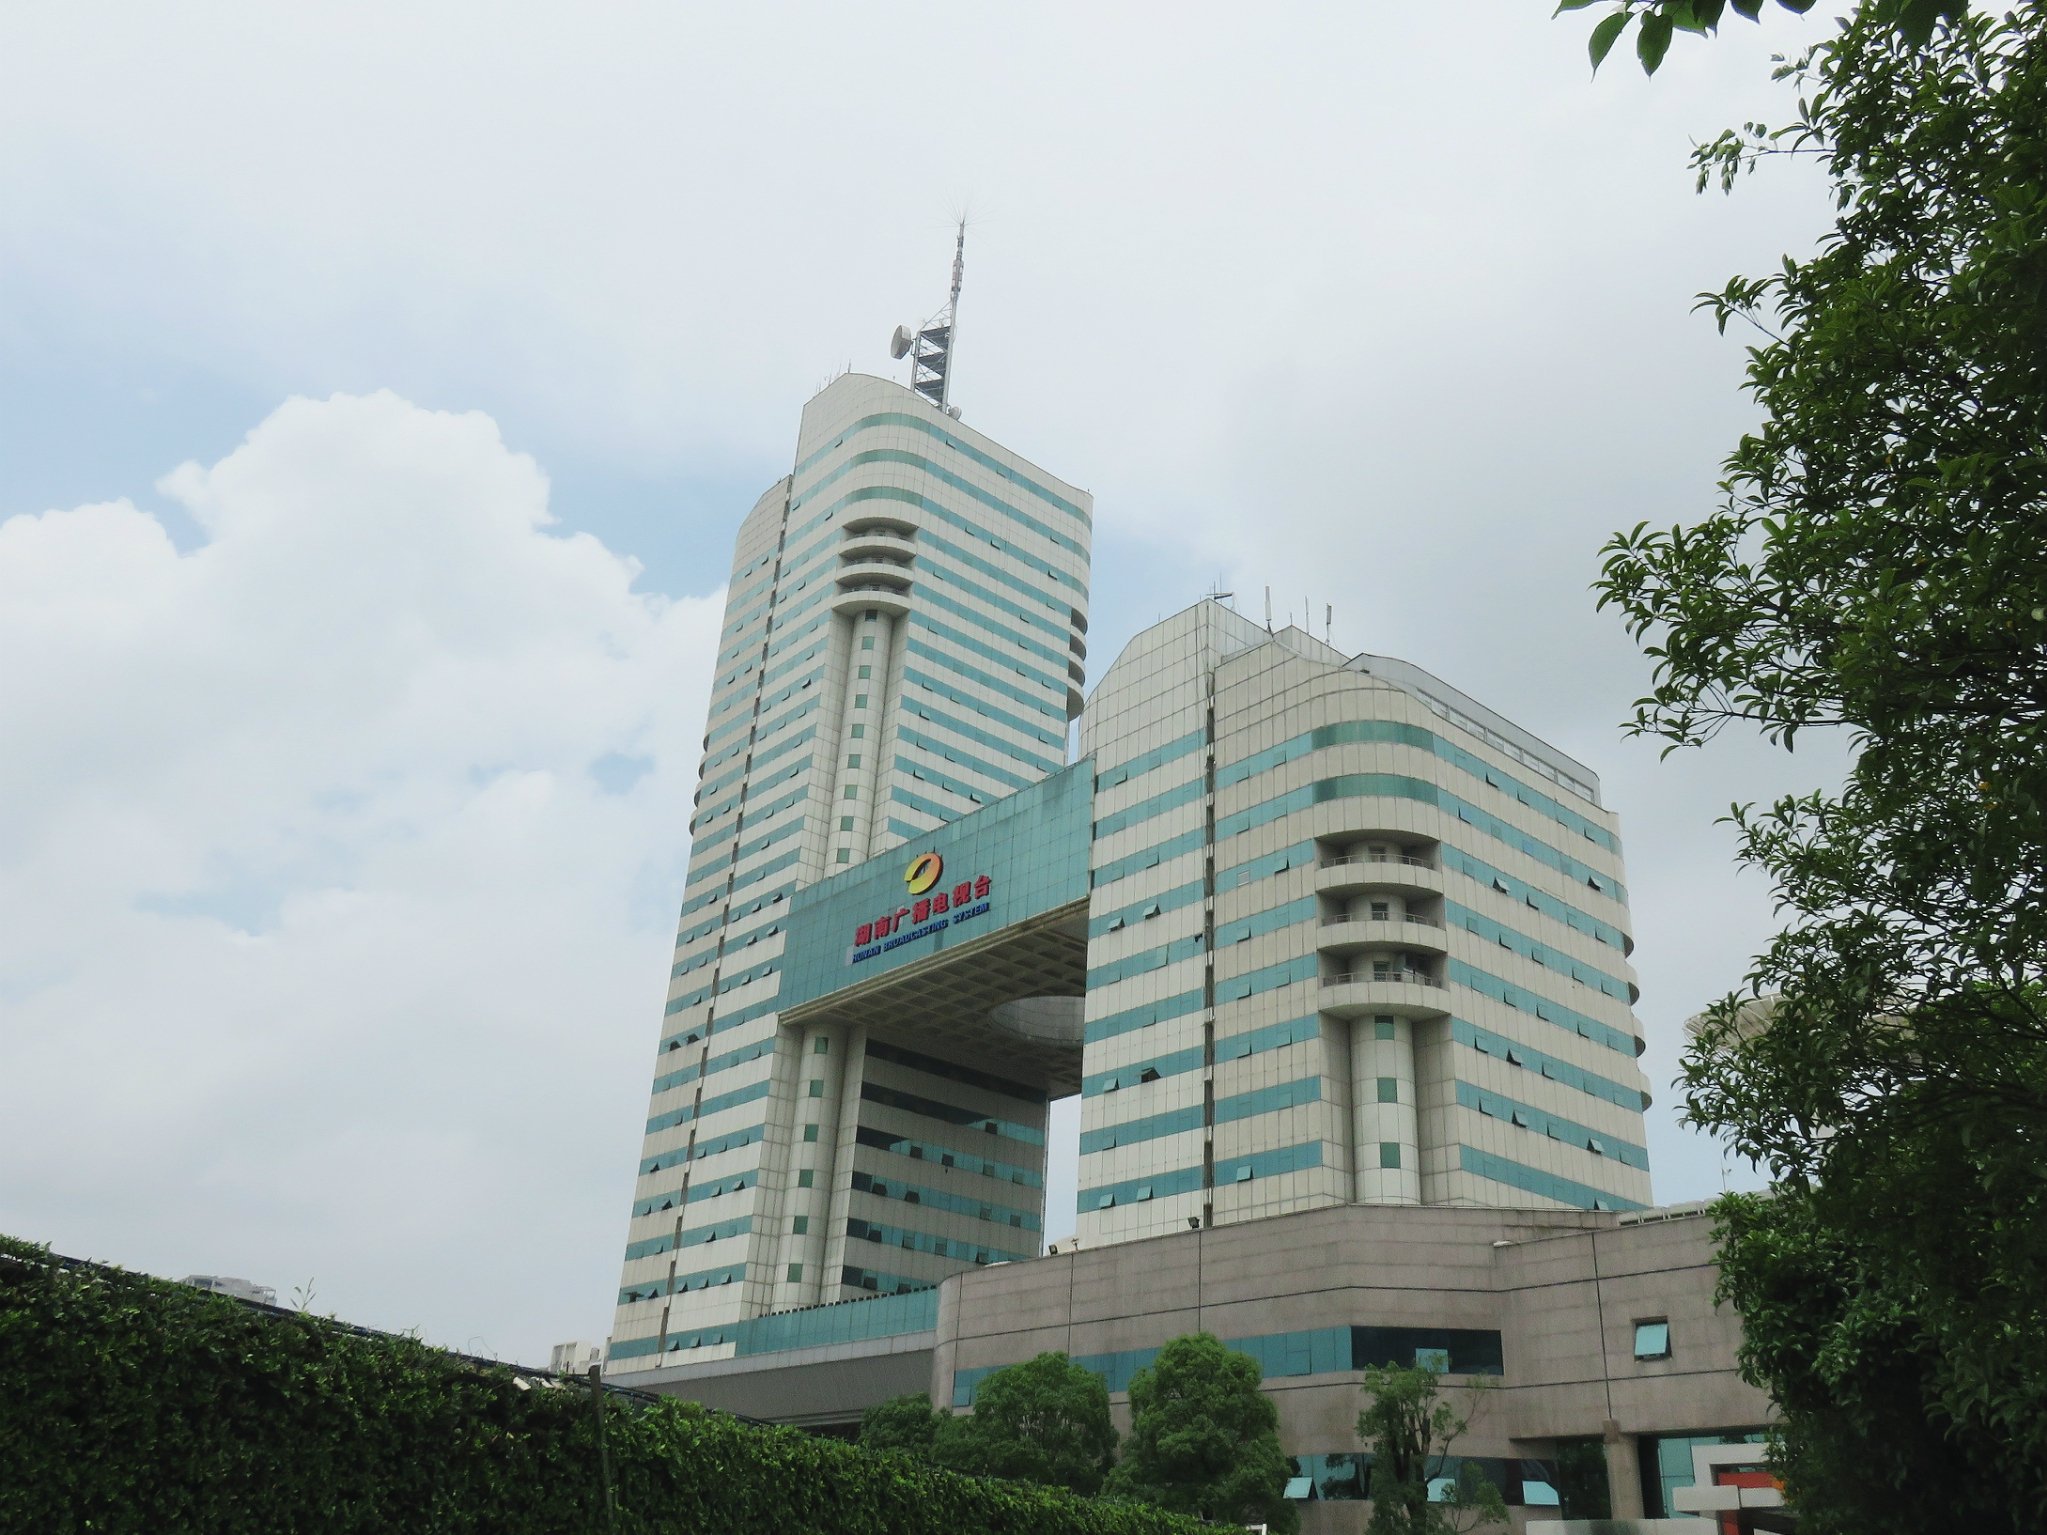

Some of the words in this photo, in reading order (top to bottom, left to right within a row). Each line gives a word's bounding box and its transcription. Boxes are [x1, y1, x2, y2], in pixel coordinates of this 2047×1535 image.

[852, 945, 881, 963] HUNAN
[884, 919, 949, 951] BROADCASTING
[953, 902, 990, 924] SYSTEM
[854, 875, 992, 947] 湖南广播电视台
